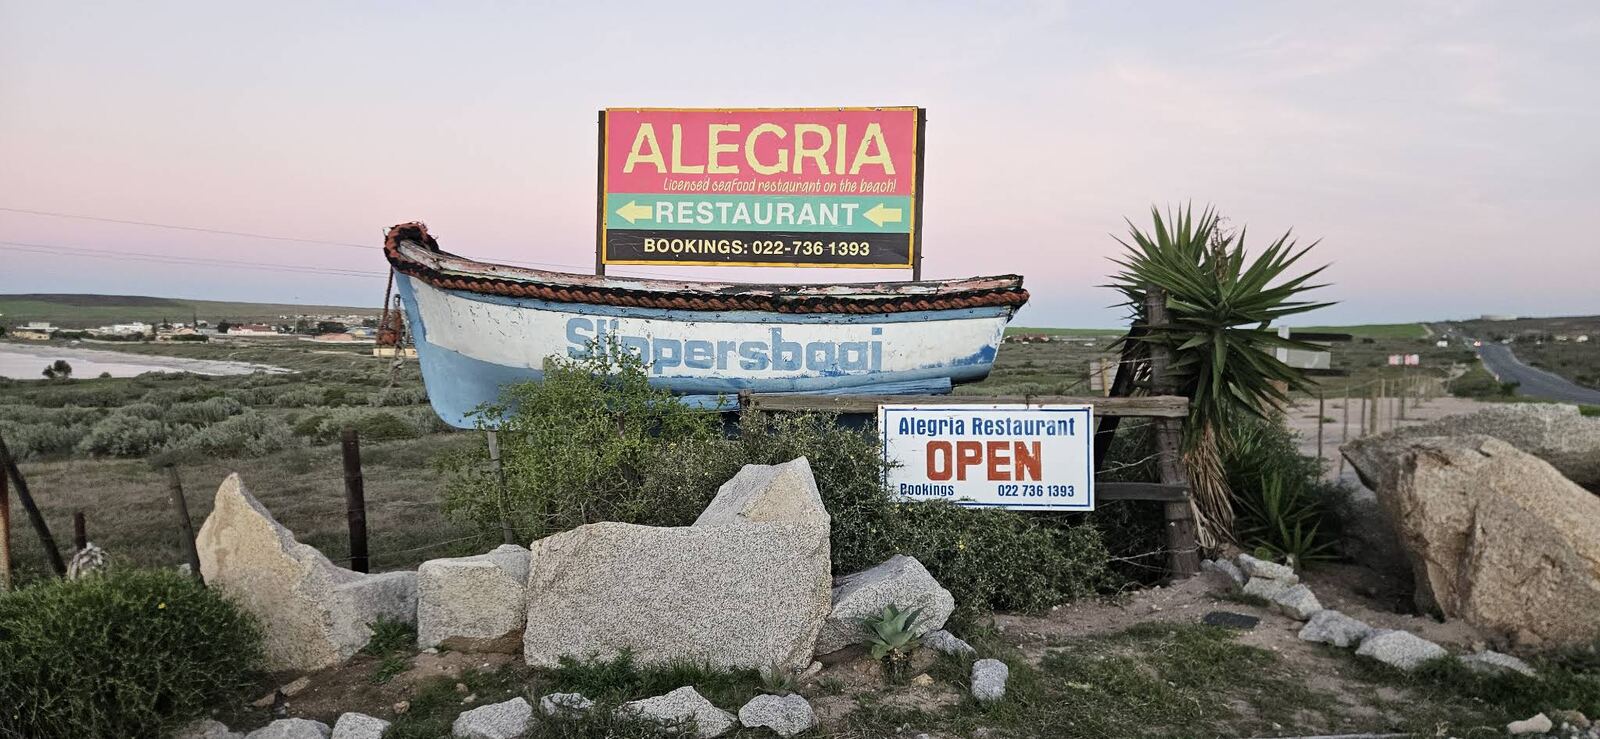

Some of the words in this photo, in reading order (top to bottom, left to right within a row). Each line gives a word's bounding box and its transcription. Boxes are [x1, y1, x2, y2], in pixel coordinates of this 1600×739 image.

[622, 122, 896, 175] ALEGRIA
[663, 177, 711, 191] Licensed
[758, 178, 821, 193] restaurant
[823, 182, 837, 193] on
[839, 179, 857, 193] the
[859, 179, 897, 194] beach!
[655, 201, 860, 226] RESTAURANT
[644, 238, 748, 255] BOOKINGS:
[752, 240, 824, 256] 022-736
[828, 241, 870, 256] 1393
[899, 416, 965, 437] Alegria
[972, 416, 1075, 437] Restaurant
[926, 440, 1043, 482] OPEN
[900, 482, 955, 497] Bookings
[997, 484, 1019, 497] 022
[1022, 484, 1043, 497] 736
[1047, 484, 1075, 498] 1393
